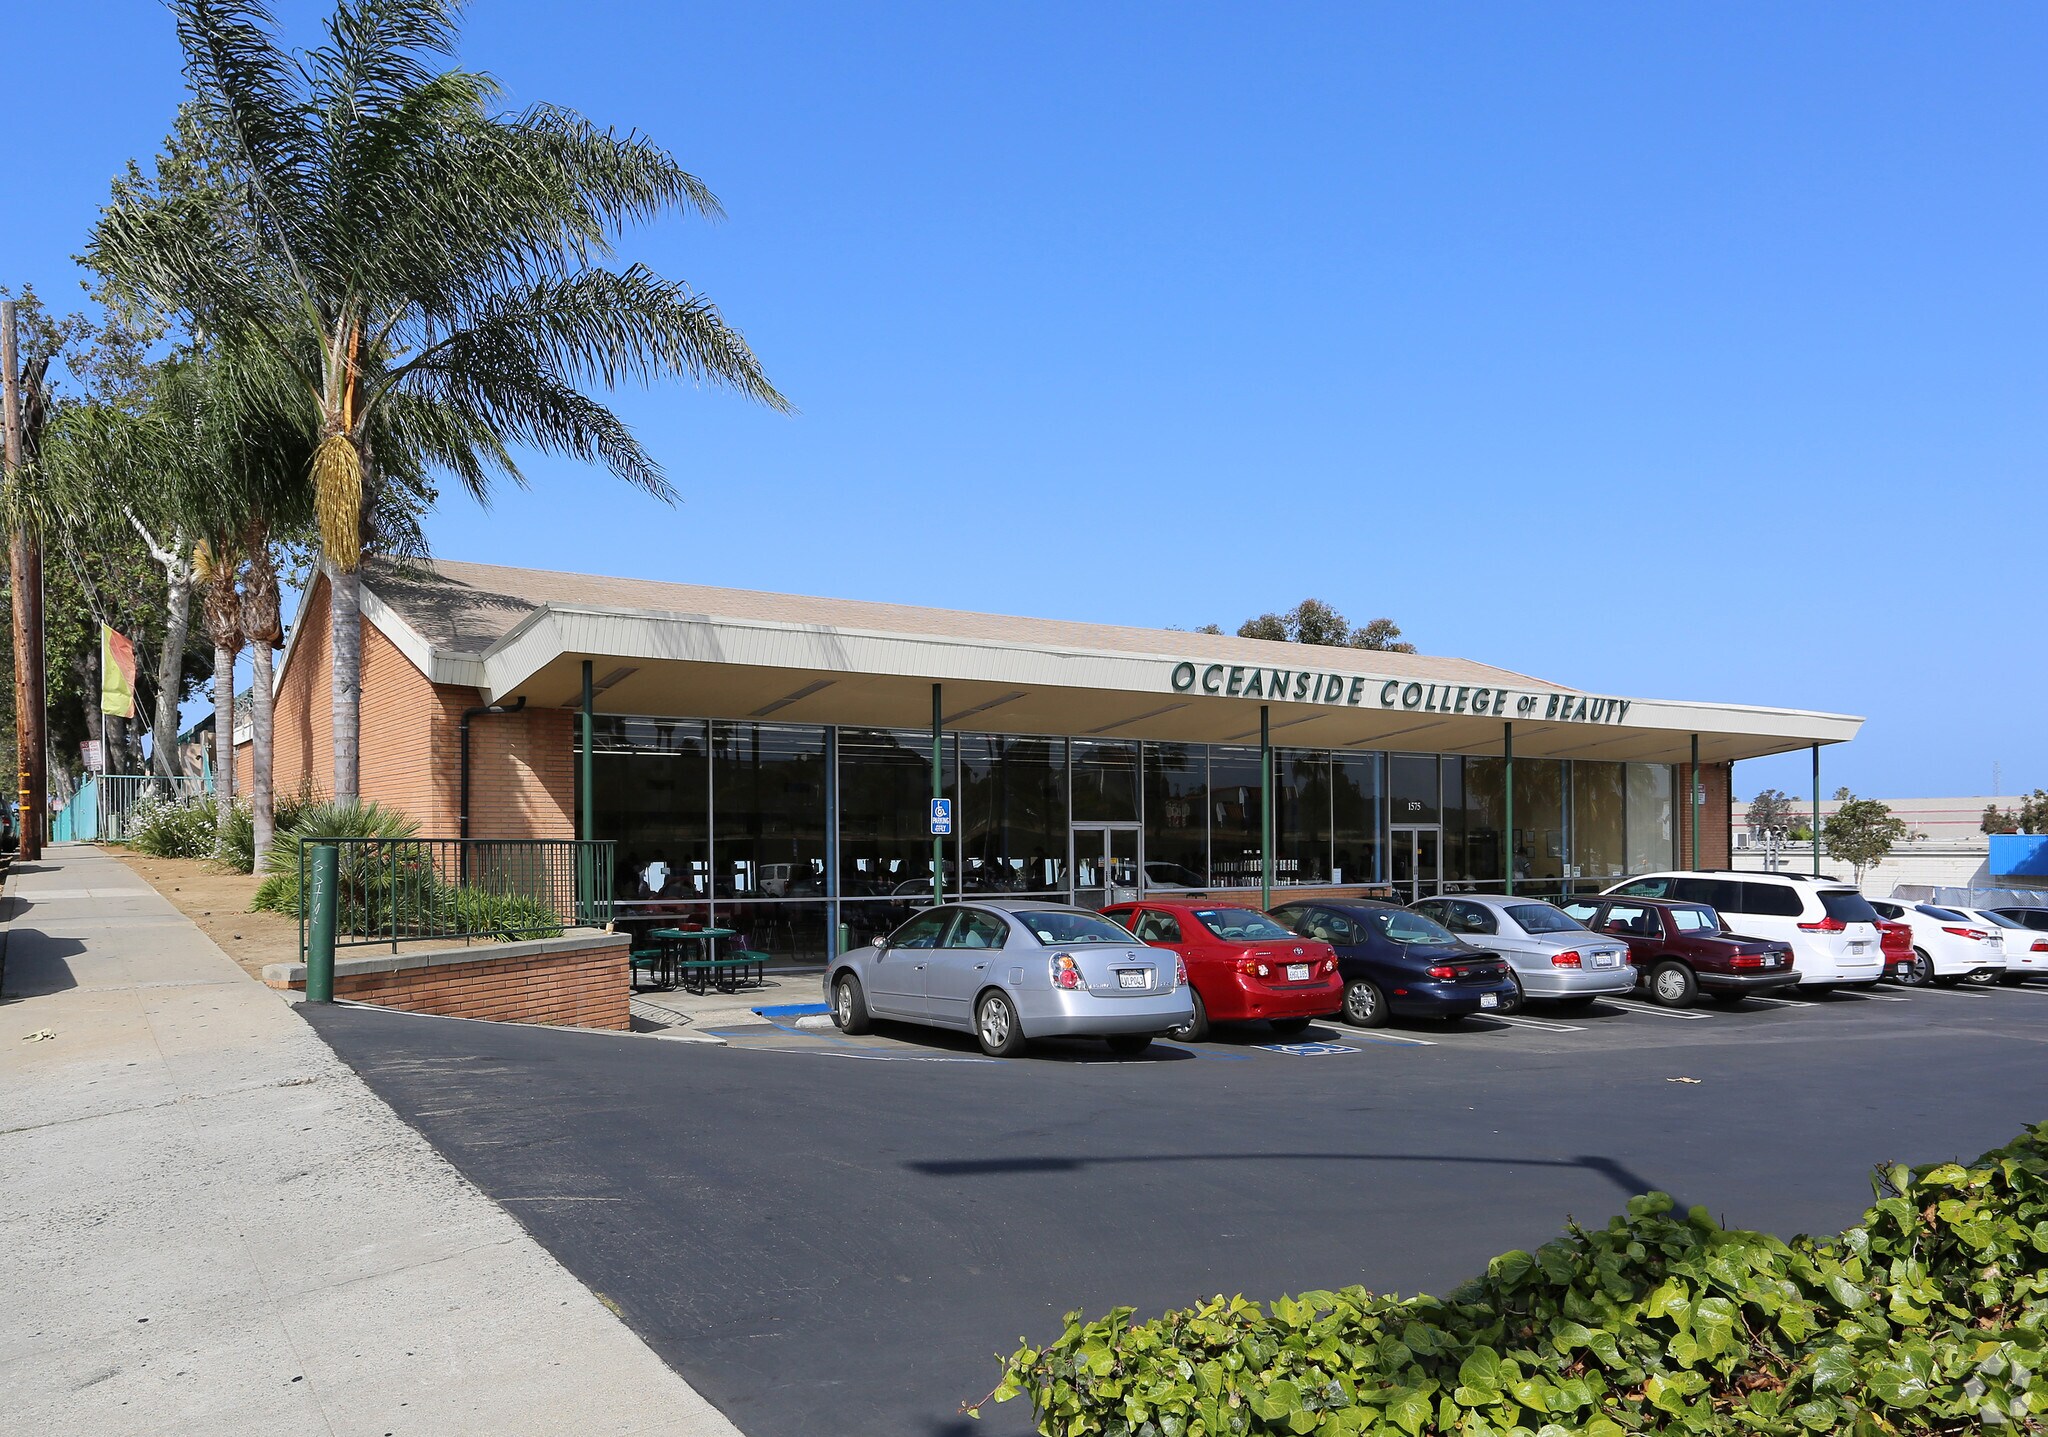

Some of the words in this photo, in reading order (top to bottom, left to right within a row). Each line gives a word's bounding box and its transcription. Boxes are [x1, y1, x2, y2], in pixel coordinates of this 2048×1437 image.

[1171, 661, 1365, 704] OCEANSIDE
[1380, 680, 1508, 715] COLLEGE
[1517, 695, 1538, 712] OF
[1545, 693, 1631, 724] BEAUTY
[1408, 802, 1421, 811] 1575
